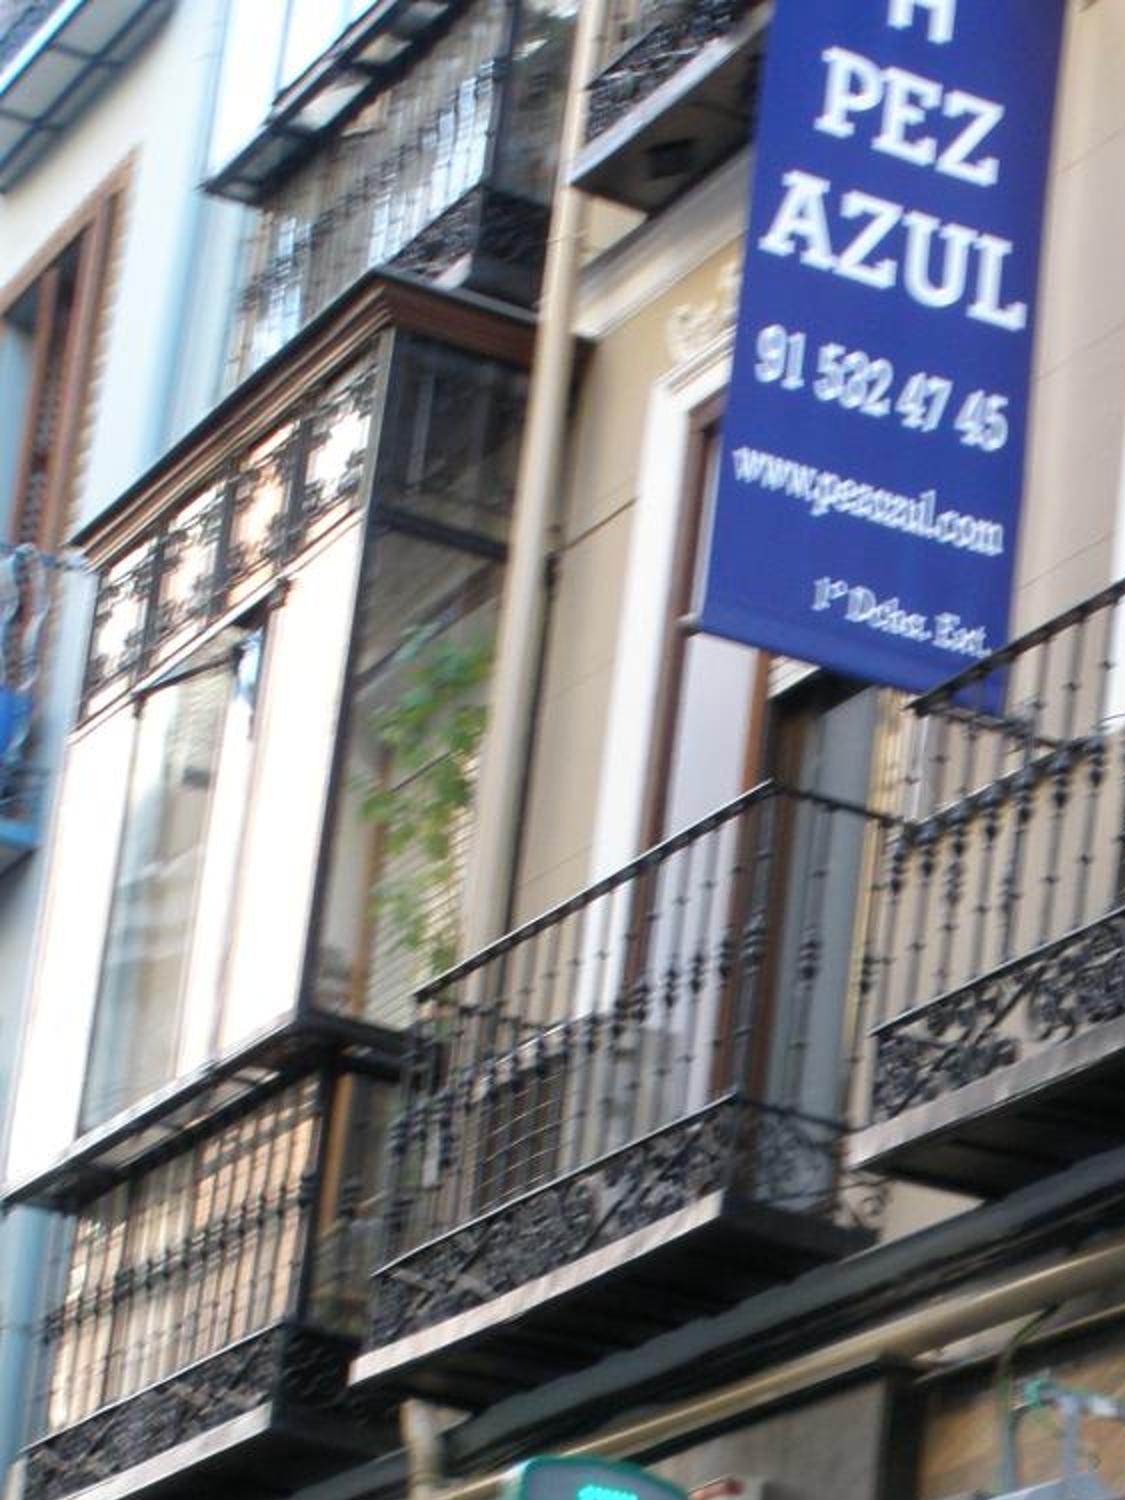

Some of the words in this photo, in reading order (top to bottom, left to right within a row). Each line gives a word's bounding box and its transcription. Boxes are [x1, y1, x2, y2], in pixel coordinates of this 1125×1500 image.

[813, 46, 1005, 187] PEZ
[758, 170, 1028, 332] AZUL
[754, 324, 806, 390] 91
[895, 371, 953, 432] 47
[954, 389, 1009, 452] 45
[732, 447, 1005, 556] www.pezazul.com
